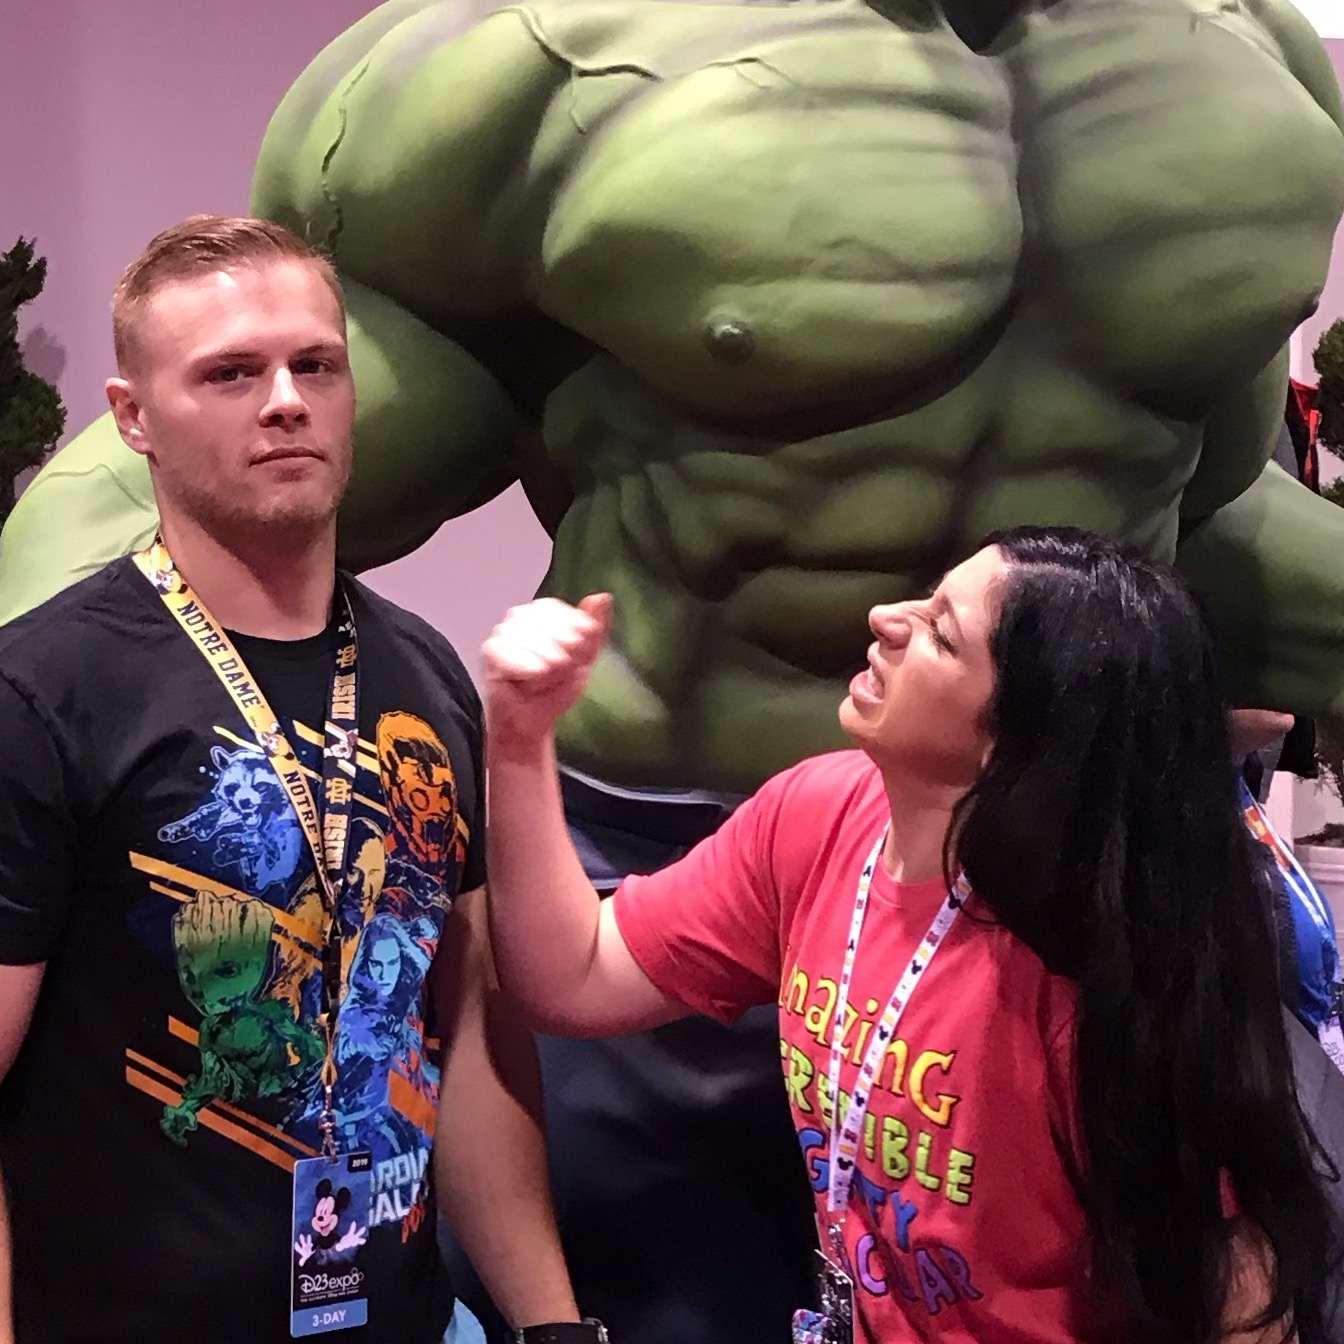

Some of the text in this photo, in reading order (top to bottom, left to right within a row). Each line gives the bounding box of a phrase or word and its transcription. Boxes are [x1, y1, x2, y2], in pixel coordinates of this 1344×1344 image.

[177, 600, 262, 709] NOTRE DAME
[284, 770, 319, 835] NOTRE
[312, 1309, 347, 1328] 3-DAY
